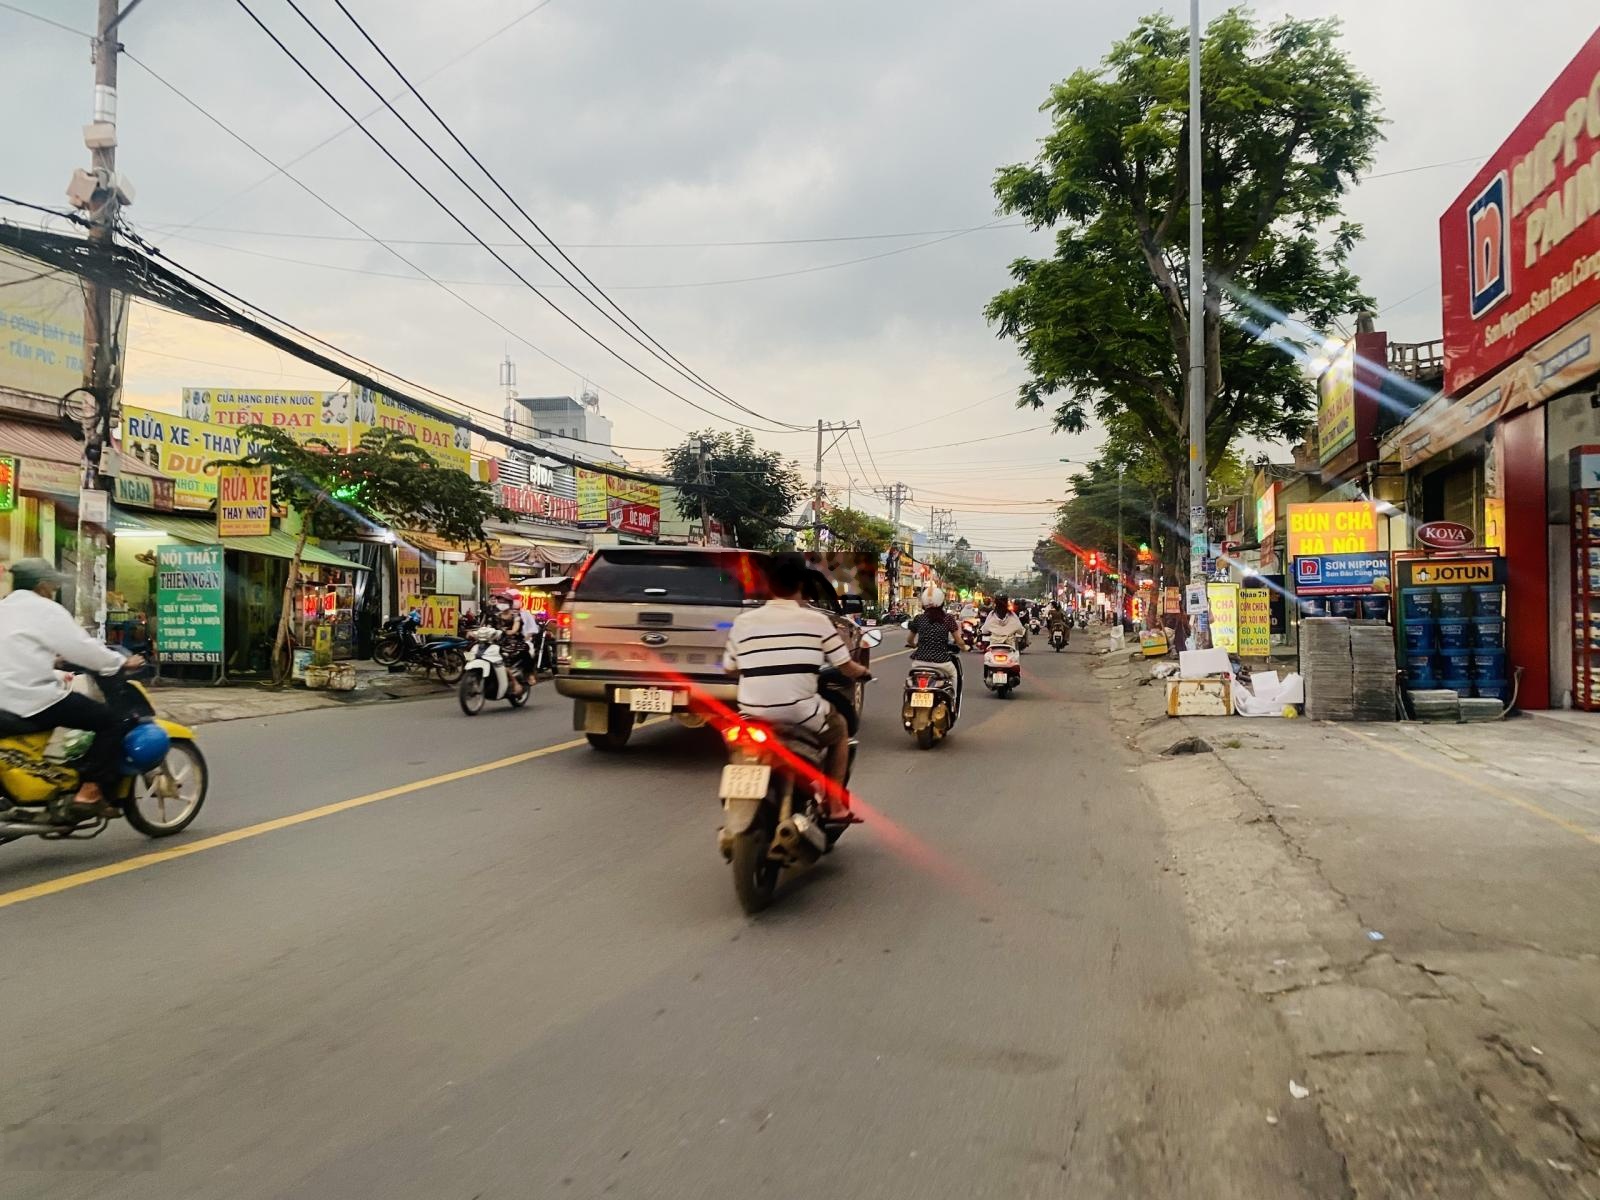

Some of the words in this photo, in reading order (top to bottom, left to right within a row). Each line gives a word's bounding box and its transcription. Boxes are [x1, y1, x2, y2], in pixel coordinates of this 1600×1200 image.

[129, 417, 163, 442] RỬA
[170, 425, 190, 446] XE
[202, 432, 241, 455] THAY
[223, 471, 248, 502] RỬA
[253, 476, 269, 501] XE
[222, 506, 243, 520] THAY
[1291, 508, 1330, 533] BÚN
[1335, 502, 1373, 531] CHẢ
[1425, 527, 1466, 541] KOVA
[1300, 534, 1325, 556] HÀ
[160, 550, 182, 566] NỘI
[186, 548, 218, 566] THẤT
[1325, 561, 1346, 570] SƠN
[1348, 559, 1387, 569] NIPPON
[1433, 565, 1490, 581] JOTUN
[438, 607, 455, 629] XE
